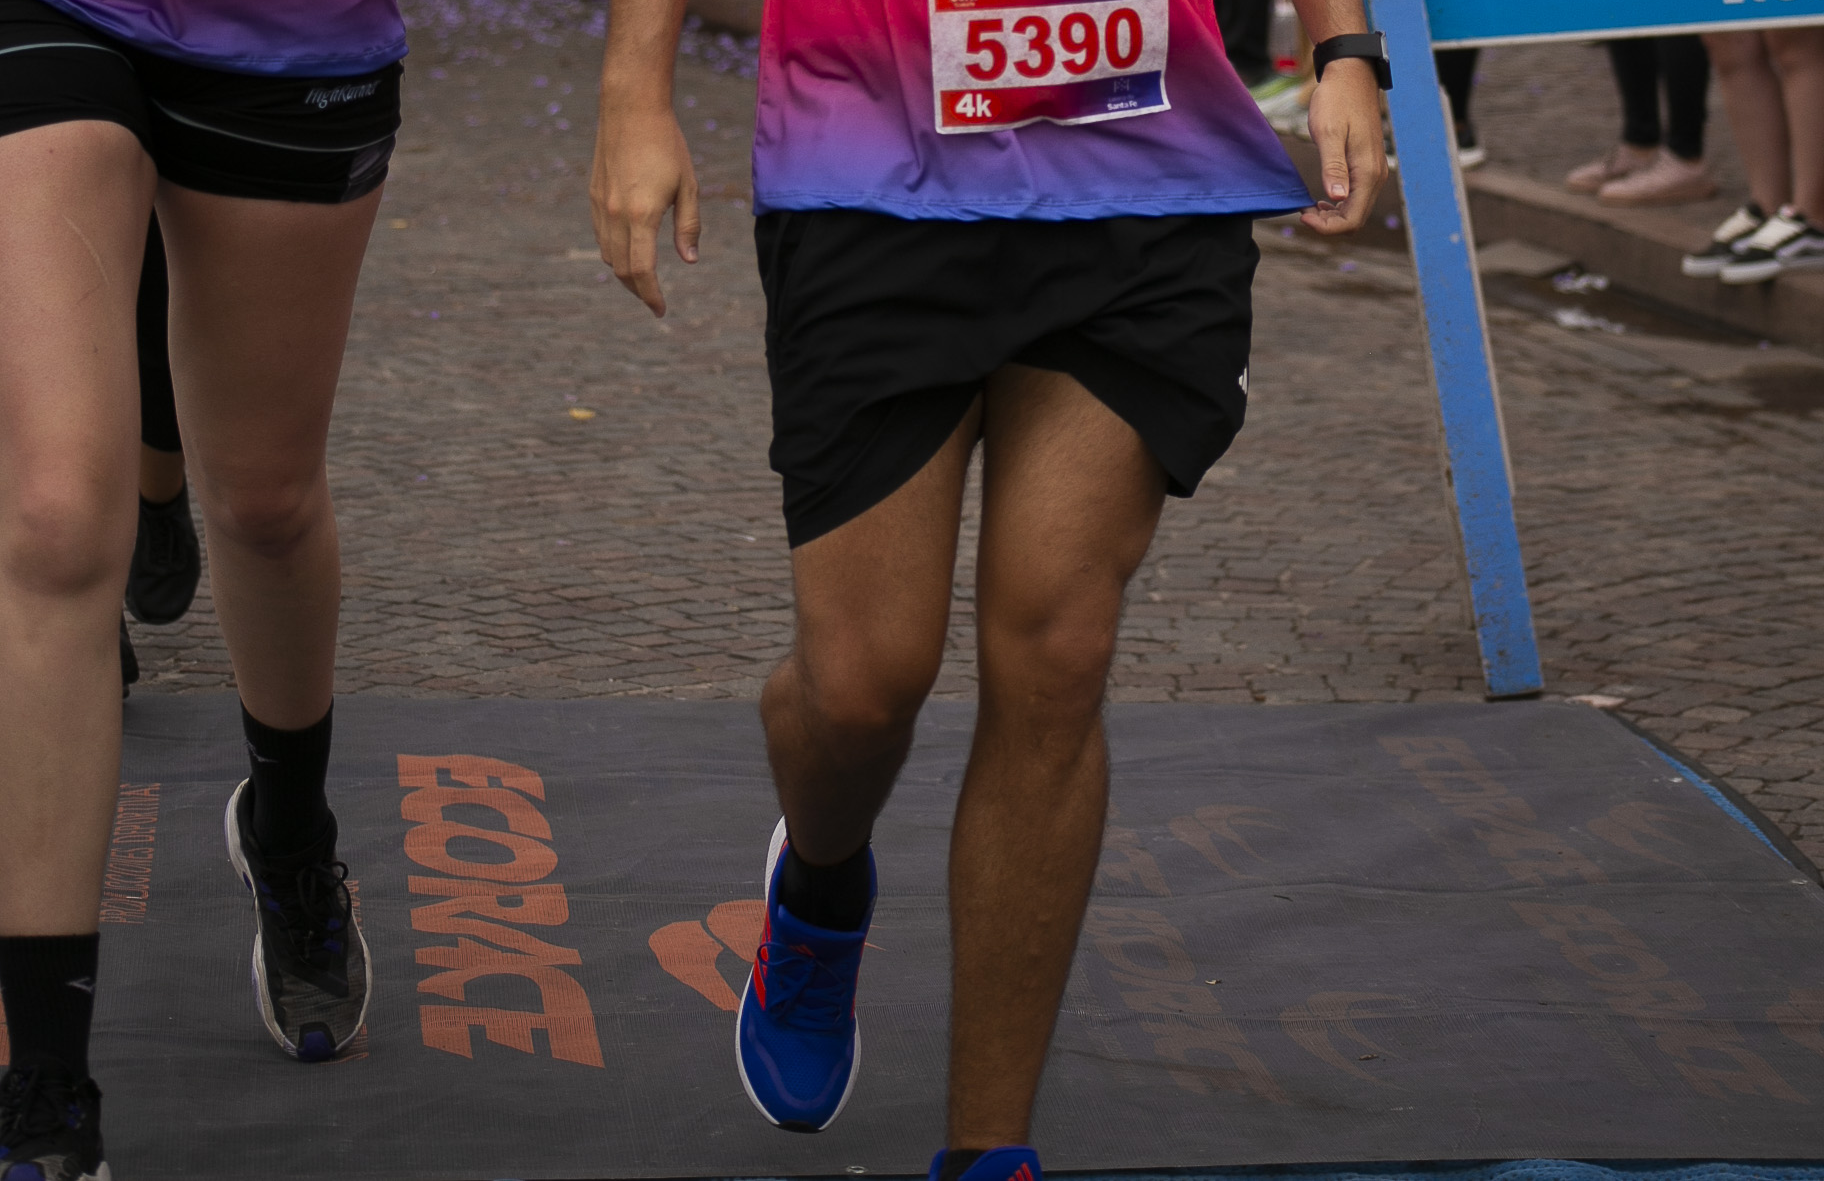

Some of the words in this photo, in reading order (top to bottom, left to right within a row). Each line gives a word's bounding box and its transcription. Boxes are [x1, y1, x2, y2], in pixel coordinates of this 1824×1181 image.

[964, 7, 1144, 82] 5390
[954, 93, 992, 118] 4k
[397, 754, 606, 1068] ECORACE
